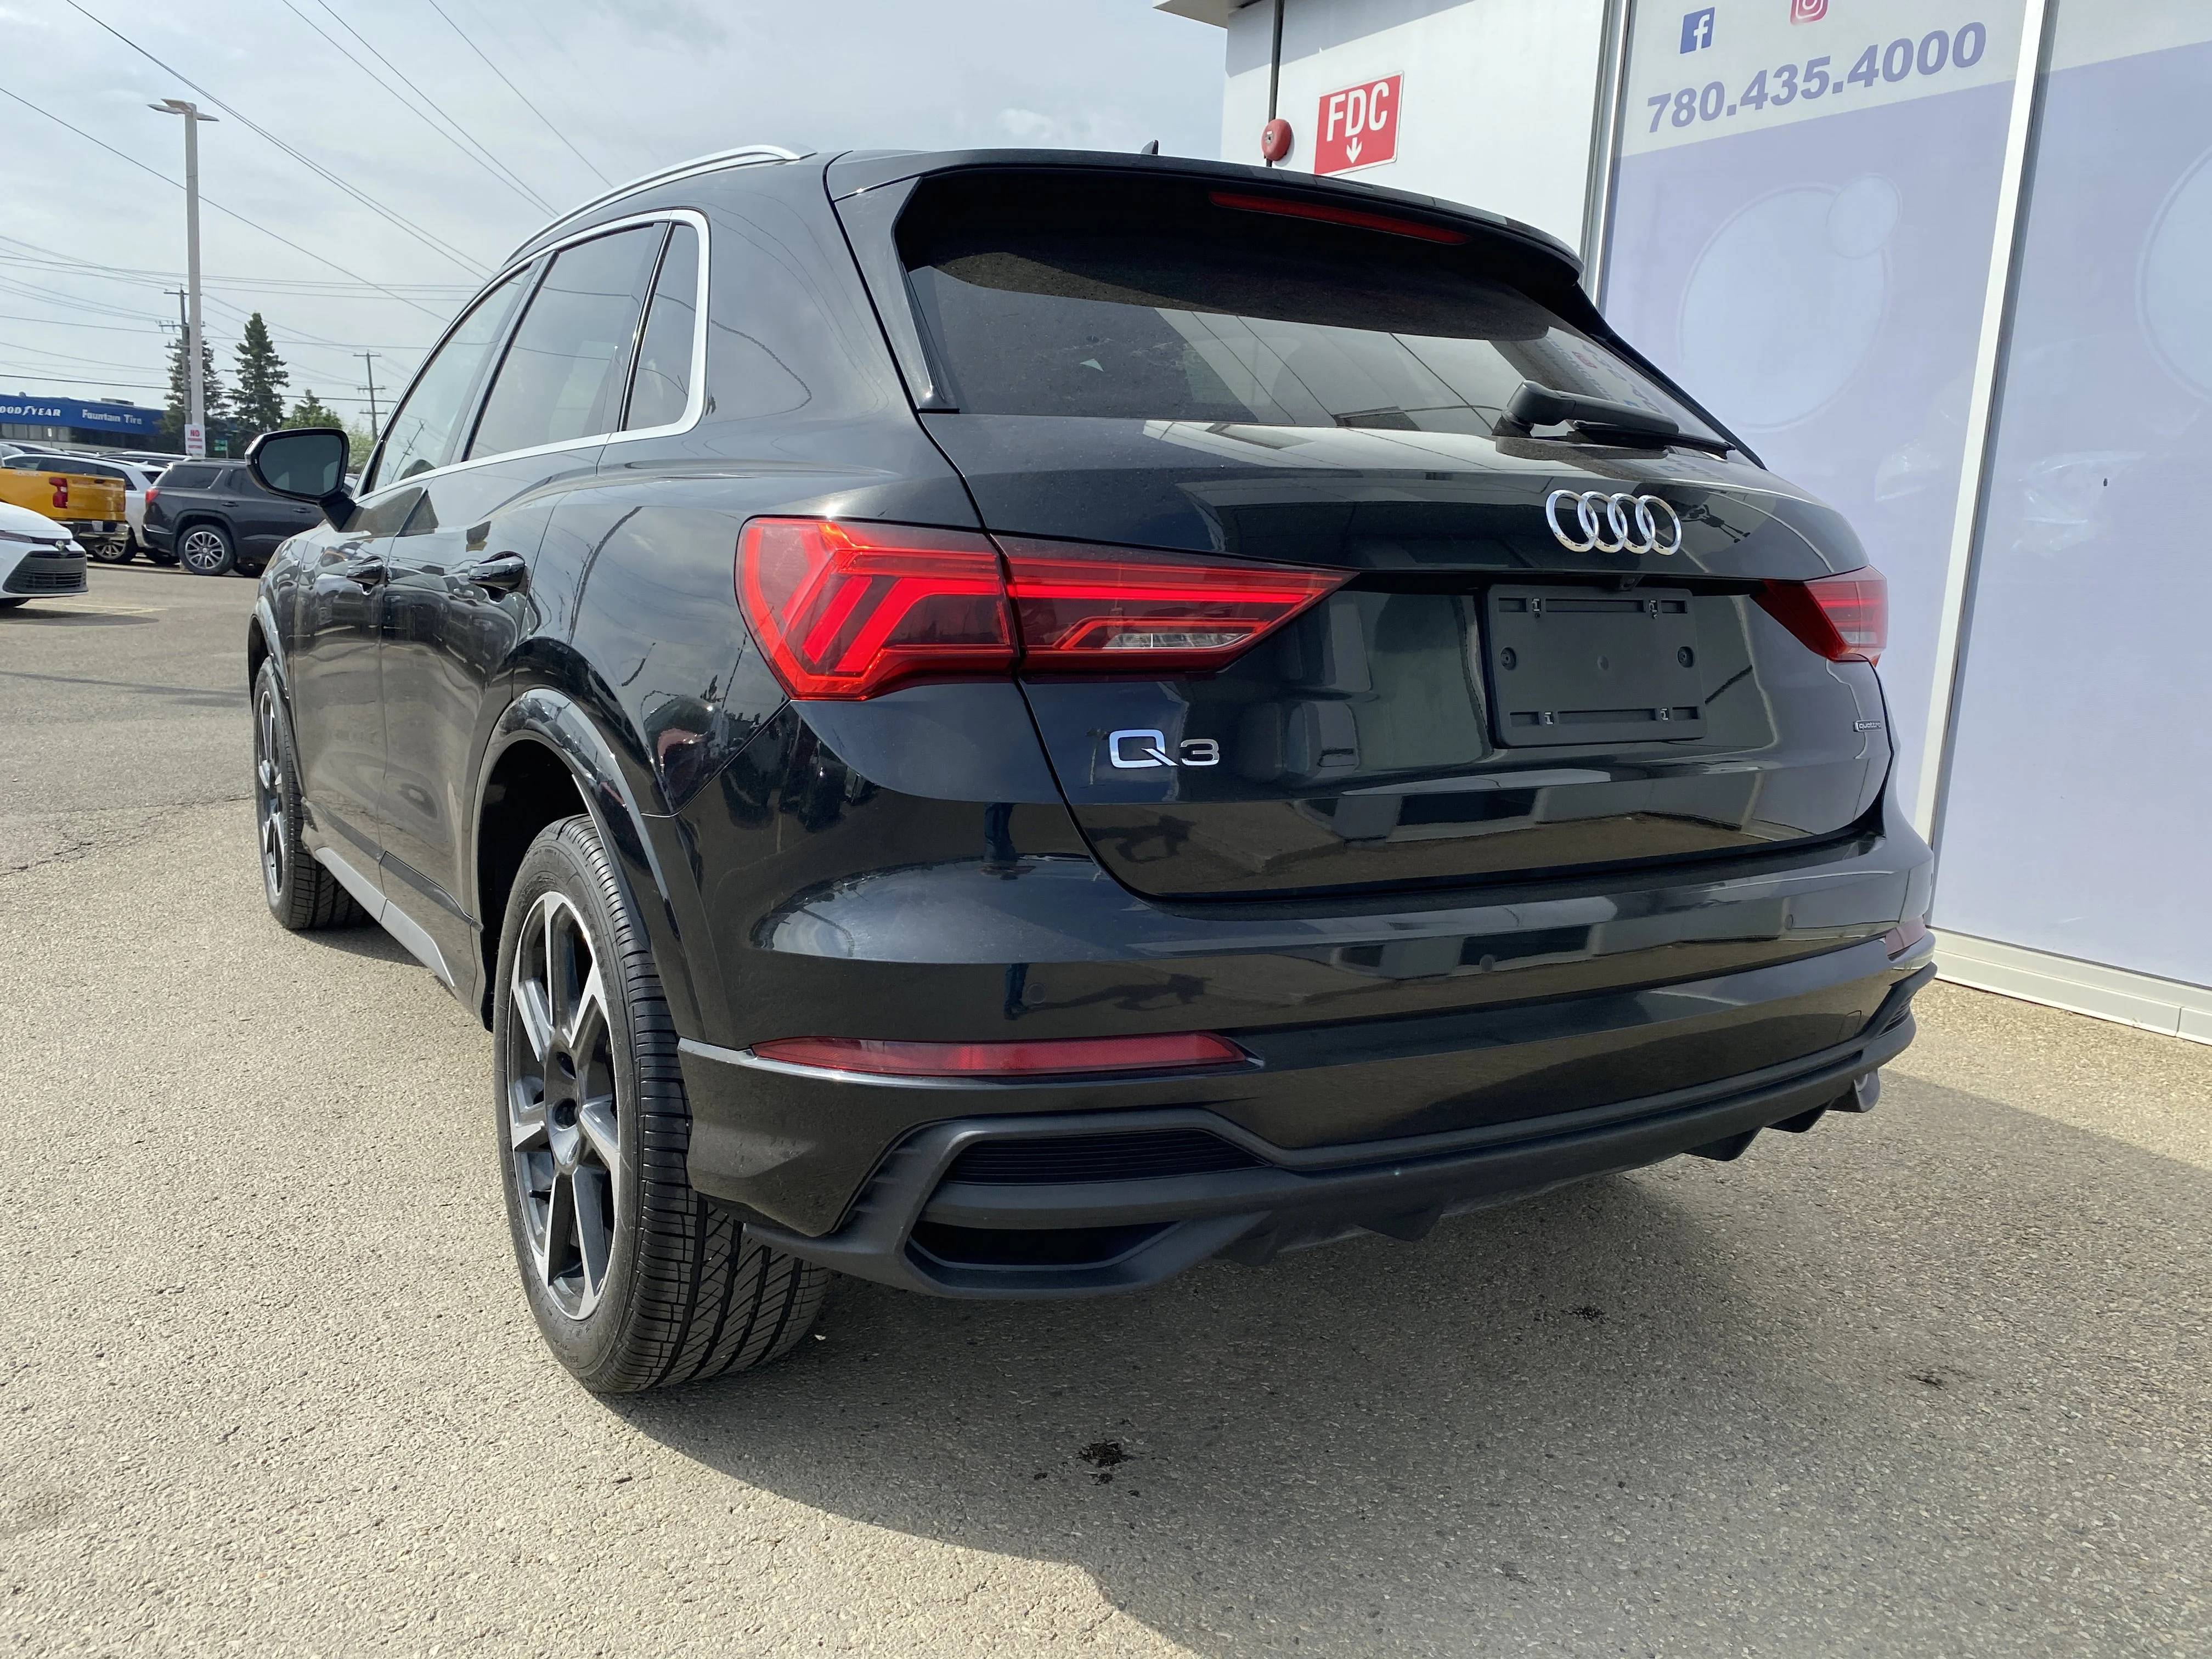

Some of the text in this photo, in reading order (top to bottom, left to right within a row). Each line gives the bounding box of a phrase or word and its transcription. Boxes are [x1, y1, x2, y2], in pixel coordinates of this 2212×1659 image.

[1647, 22, 1986, 133] 780.435.4000
[1327, 82, 1389, 142] FDC
[0, 405, 61, 416] OODYEAR
[82, 409, 142, 425] Fountain Tire
[1859, 721, 1881, 730] quattro
[1109, 729, 1220, 768] Q3
